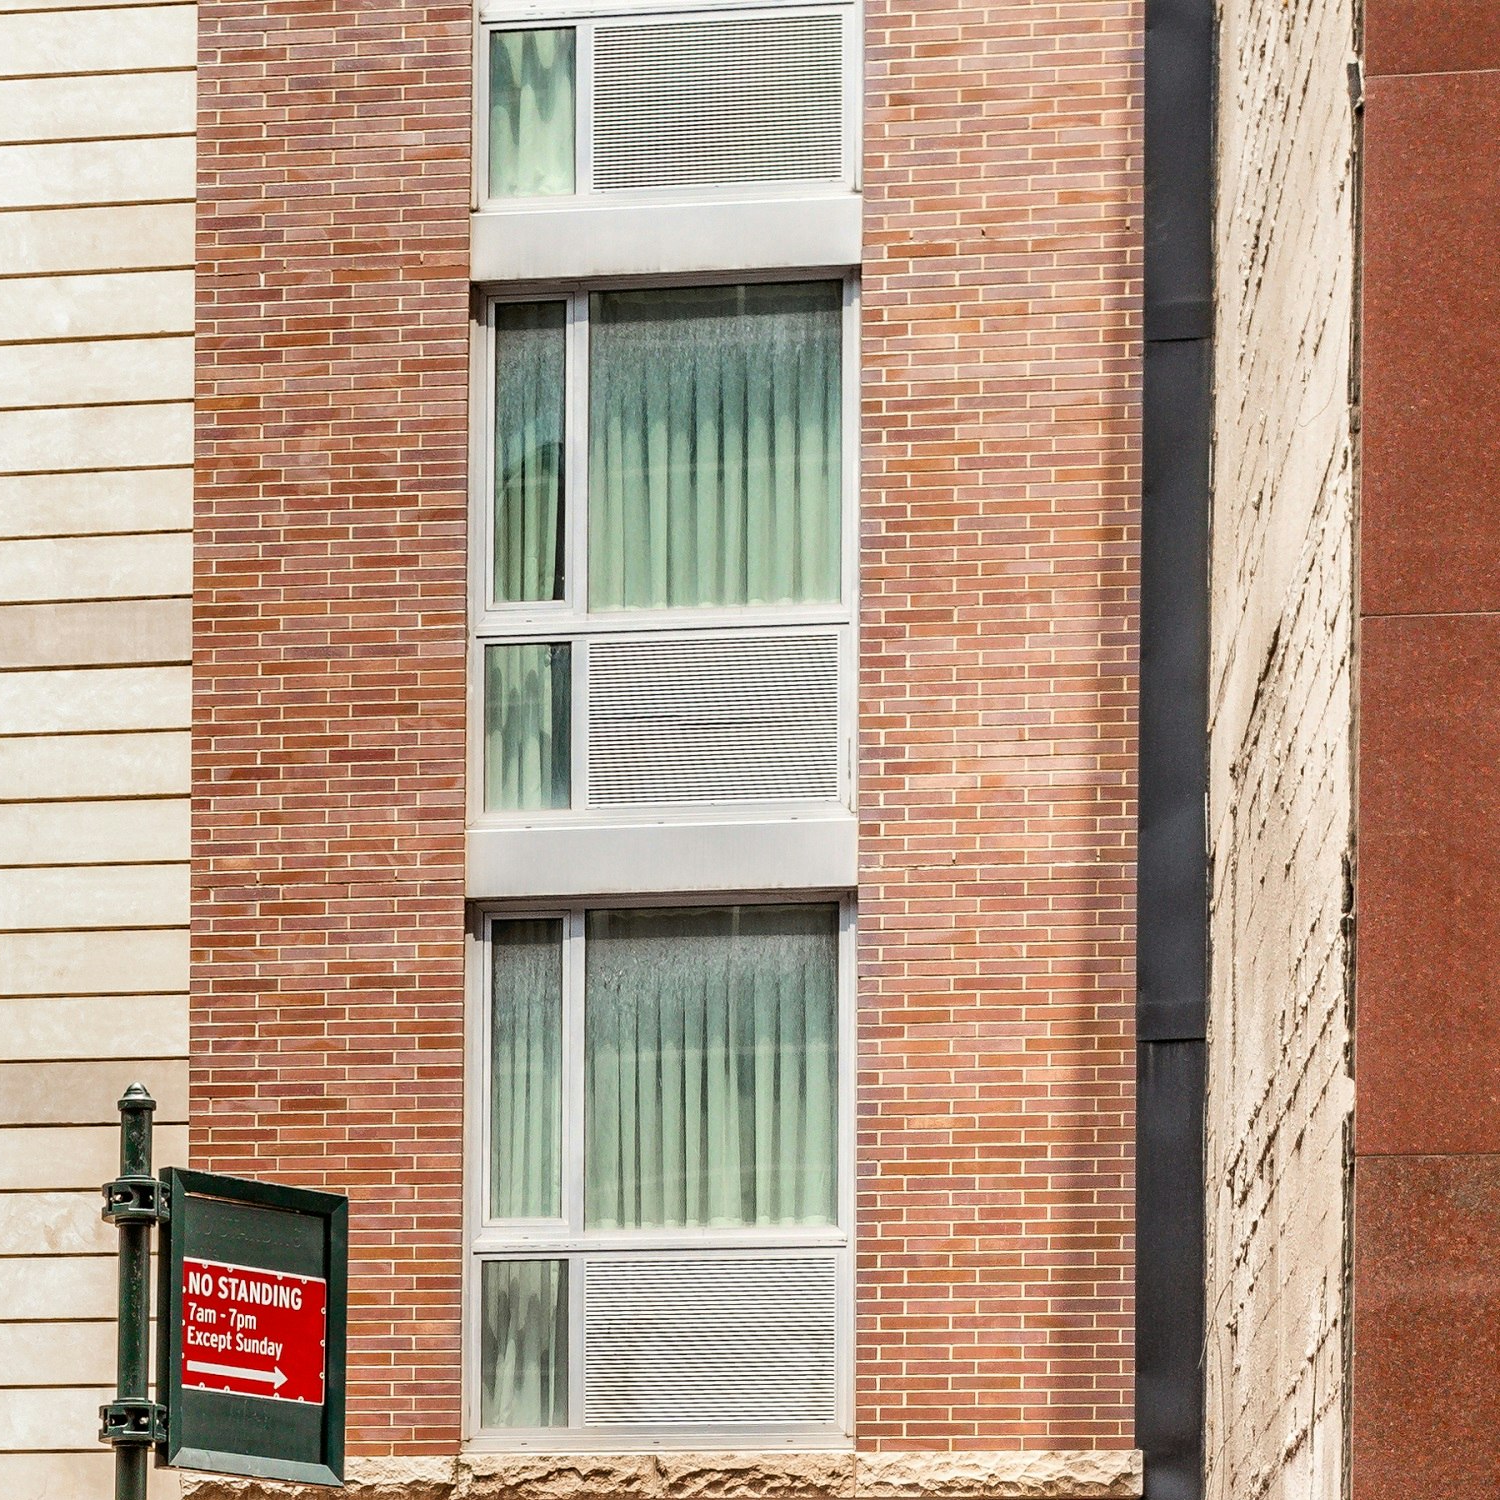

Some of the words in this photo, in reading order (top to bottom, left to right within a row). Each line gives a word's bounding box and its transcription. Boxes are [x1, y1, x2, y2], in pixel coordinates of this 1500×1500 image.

[188, 1271, 213, 1297] NO
[217, 1275, 303, 1311] STANDING
[187, 1302, 217, 1324] 7am
[228, 1308, 257, 1332] 7pm
[187, 1326, 232, 1352] Except
[235, 1333, 284, 1361] Sunday
